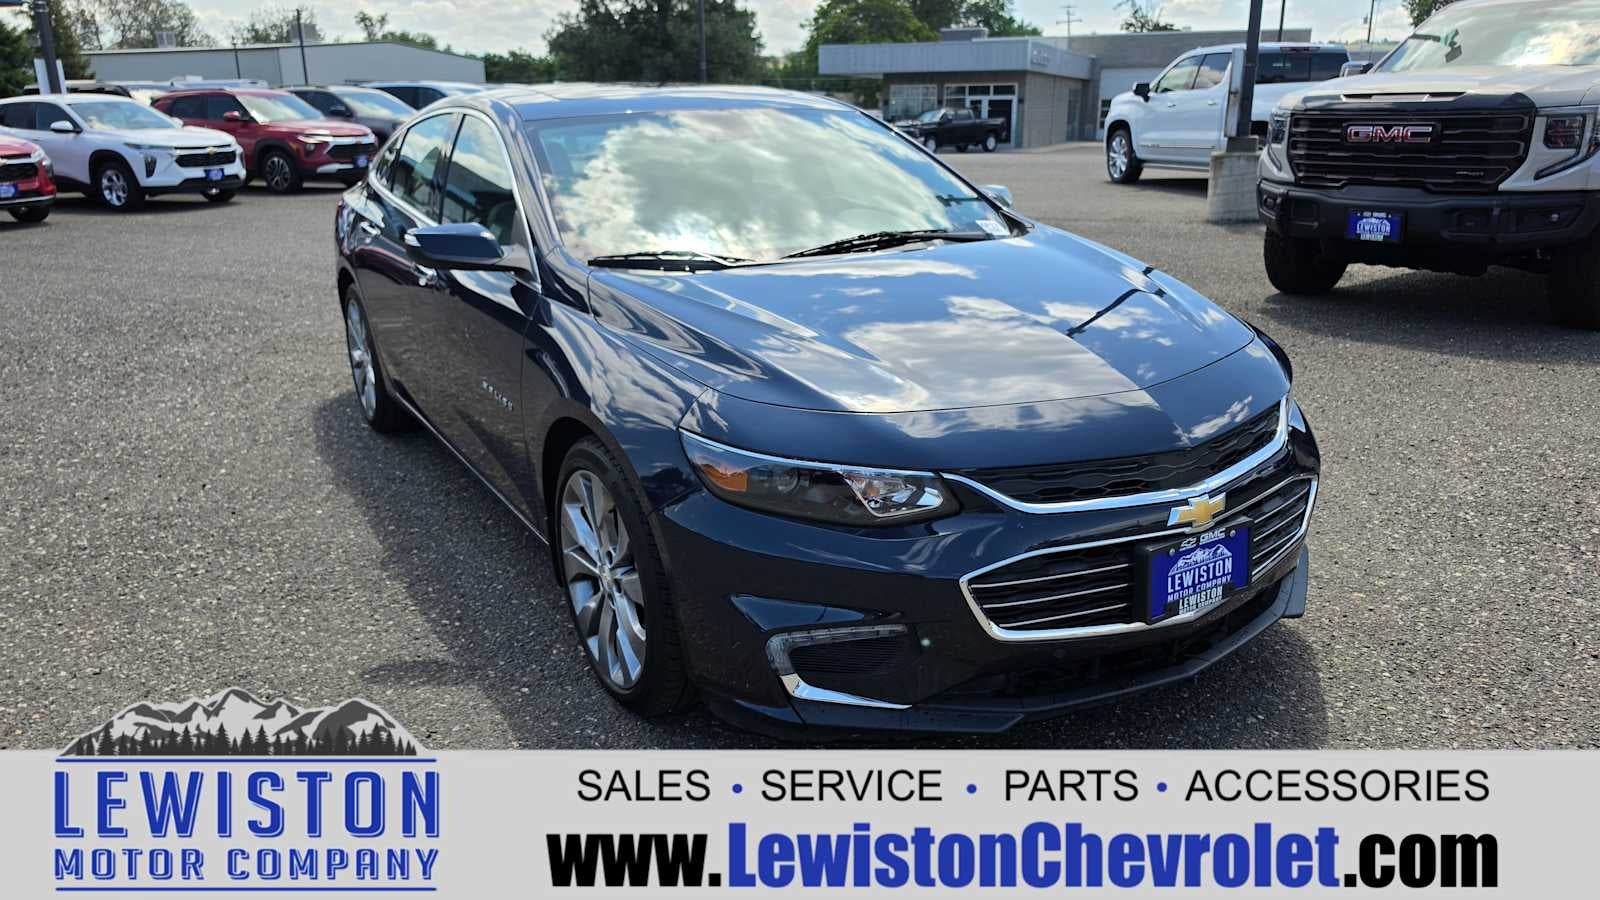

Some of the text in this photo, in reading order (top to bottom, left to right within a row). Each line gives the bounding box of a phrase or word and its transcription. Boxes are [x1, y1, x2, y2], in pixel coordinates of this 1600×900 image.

[1347, 126, 1433, 142] GMC
[1200, 528, 1226, 541] GMC
[1167, 557, 1233, 594] LEWISTON
[1168, 574, 1232, 603] MOTOR COMPANY
[1179, 585, 1223, 609] LEWISTON
